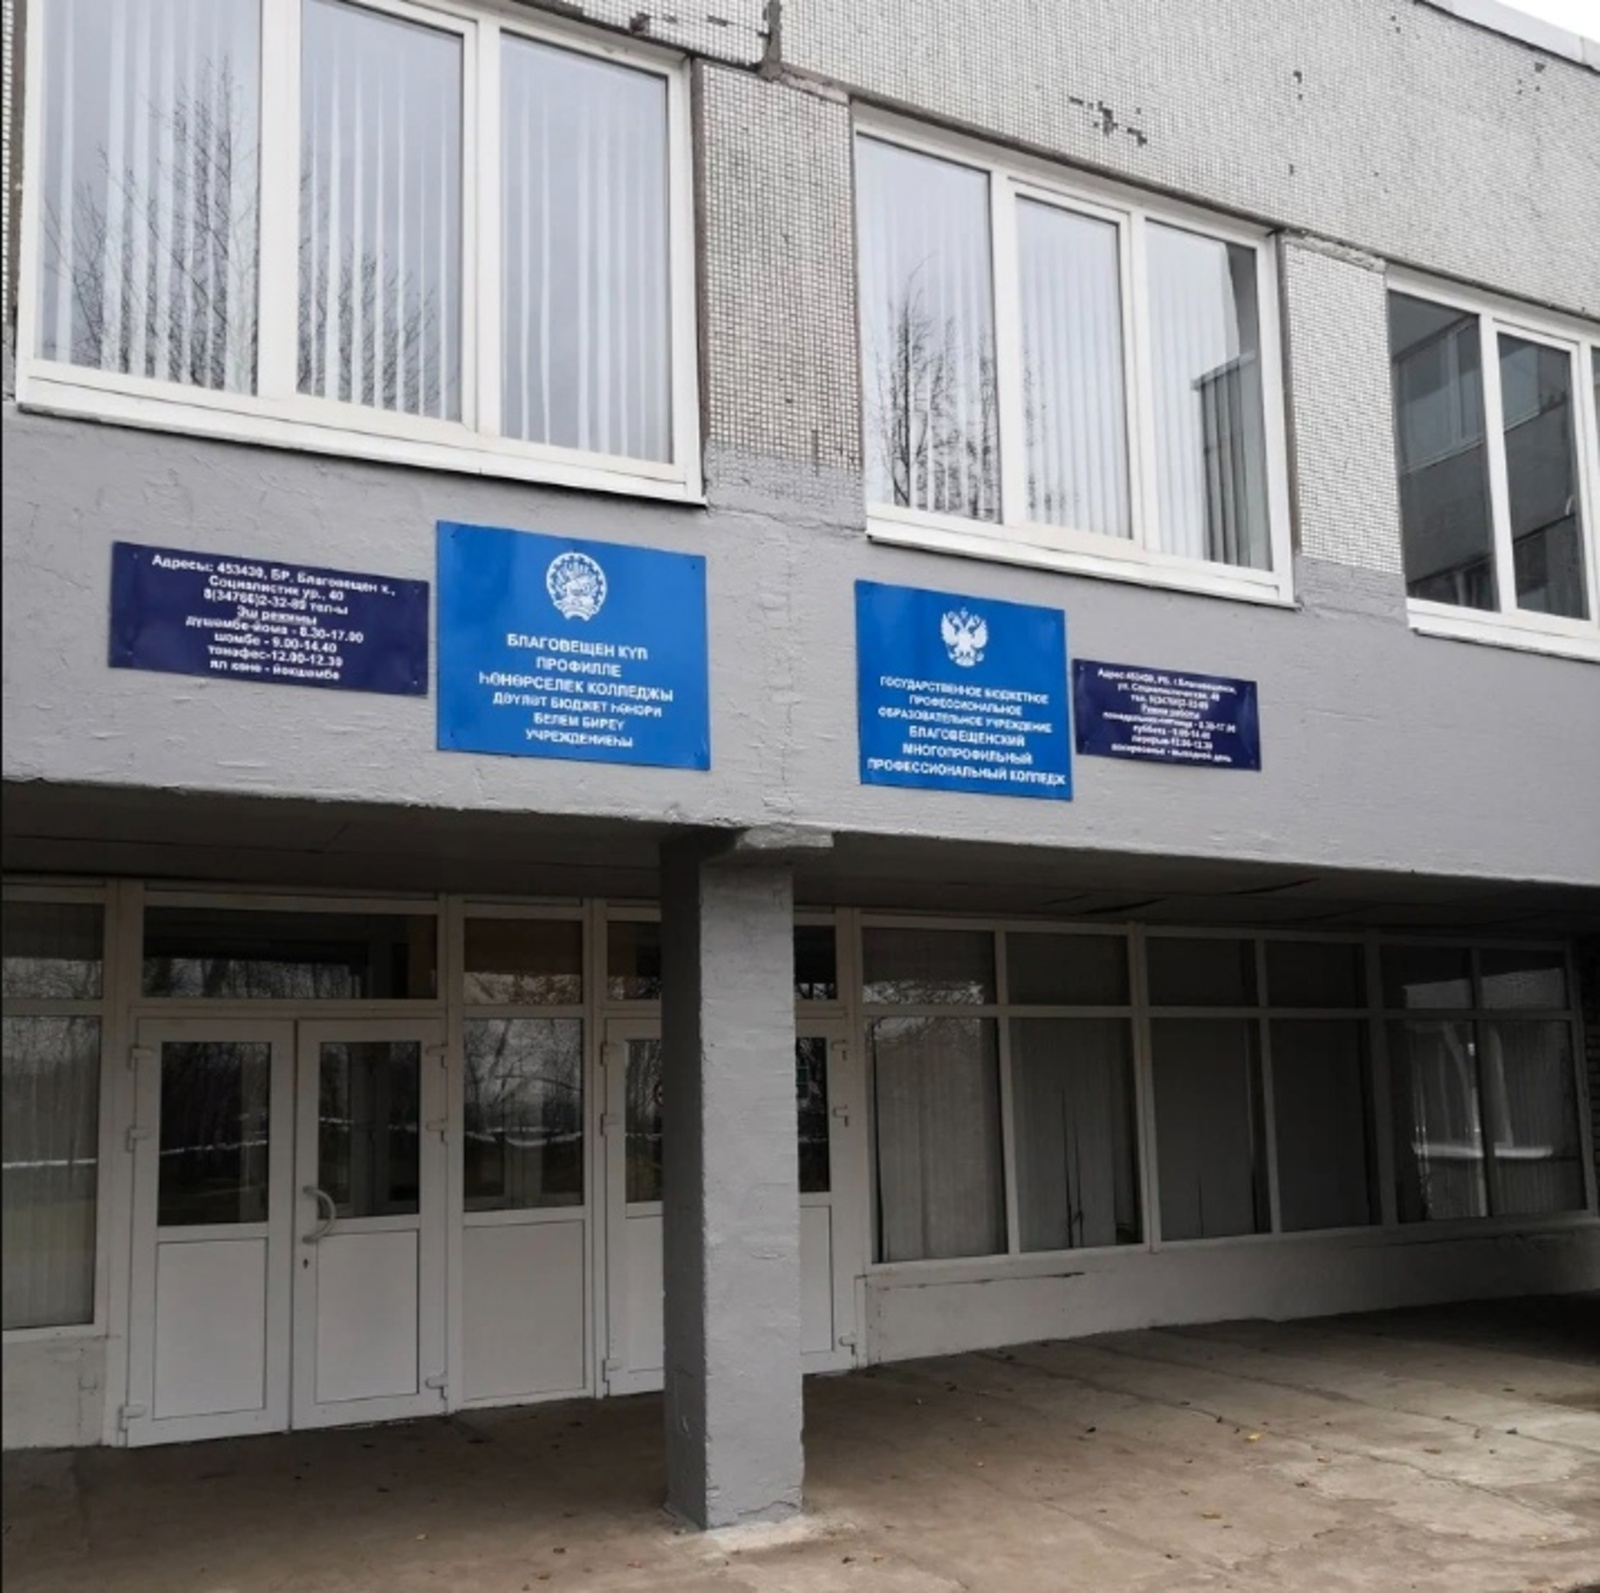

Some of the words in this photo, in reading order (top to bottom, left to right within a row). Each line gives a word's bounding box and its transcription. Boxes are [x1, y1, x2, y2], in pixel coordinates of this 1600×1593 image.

[152, 554, 214, 573] Адресы:
[507, 633, 615, 657] БЛАГОВЕЩЕН
[536, 657, 622, 678] ПРОФИЛЛЕ
[880, 676, 982, 698] ГОСУДАРСТВЕННОЕ
[984, 688, 1049, 704] БЮДЖЕТНОЕ
[550, 698, 607, 712] БЮДЖЕТ
[909, 695, 1023, 717] ПРОФЕССИОНАЛЬНОЕ
[878, 707, 983, 727] ОБРАЗОВАТЕЛЬНОЕ
[986, 718, 1053, 733] УЧРЕЖДЕНИЕ
[909, 725, 1026, 747] БЛАГОВЕЩЕНСКИЙ
[902, 743, 1033, 765] МНОГОПРОФИЛЬНЫЙ
[868, 758, 1007, 781] ПРОФЕССИОНАЛЬНЫЙ
[1010, 771, 1066, 787] КОЛЛЕДЖ
